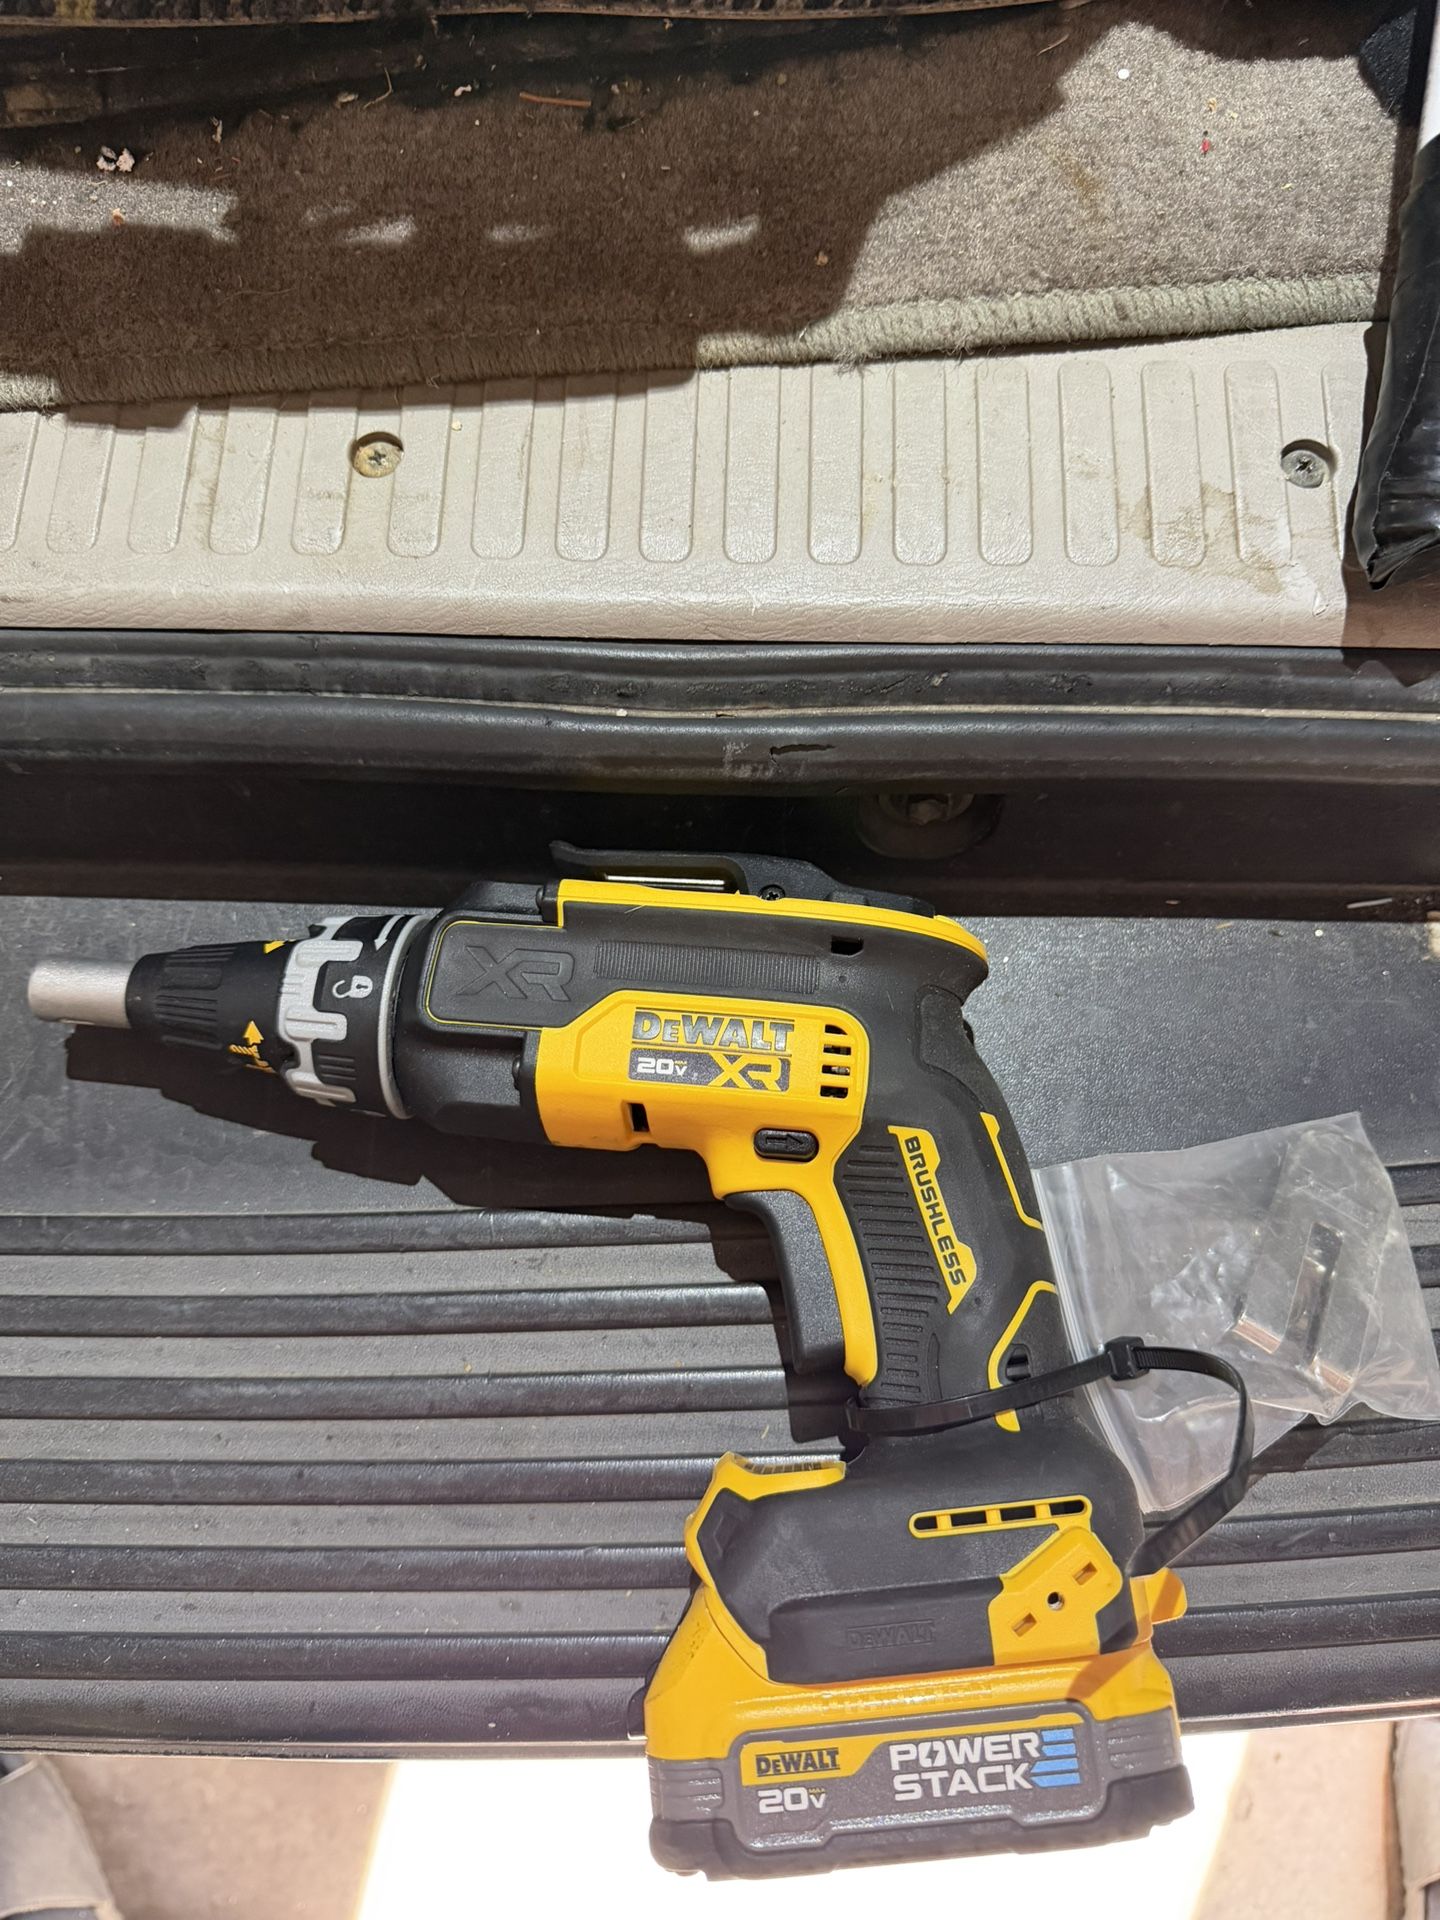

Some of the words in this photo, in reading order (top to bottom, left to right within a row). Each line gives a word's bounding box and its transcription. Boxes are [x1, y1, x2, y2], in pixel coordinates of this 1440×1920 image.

[456, 945, 575, 1002] XR
[707, 1052, 782, 1092] XR
[904, 1135, 967, 1286] BRUSHLESS
[889, 1731, 1041, 1771] POWER
[892, 1762, 1033, 1801] STACK
